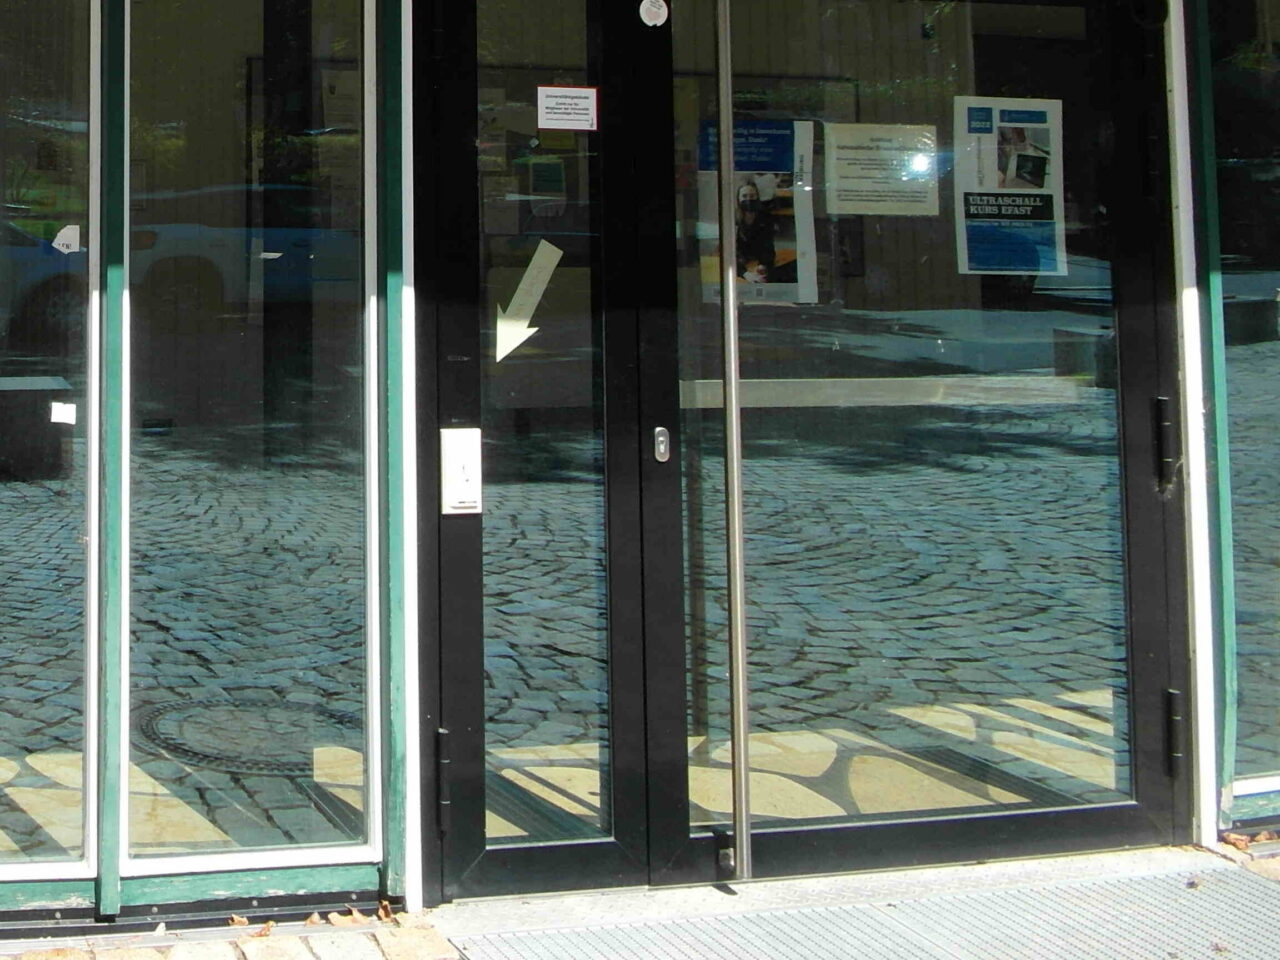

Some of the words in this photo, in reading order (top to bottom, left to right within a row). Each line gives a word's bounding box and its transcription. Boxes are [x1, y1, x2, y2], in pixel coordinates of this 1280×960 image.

[968, 195, 1043, 206] ULTRASCHALL
[969, 205, 999, 214] KURS
[1001, 206, 1033, 215] EFAST
